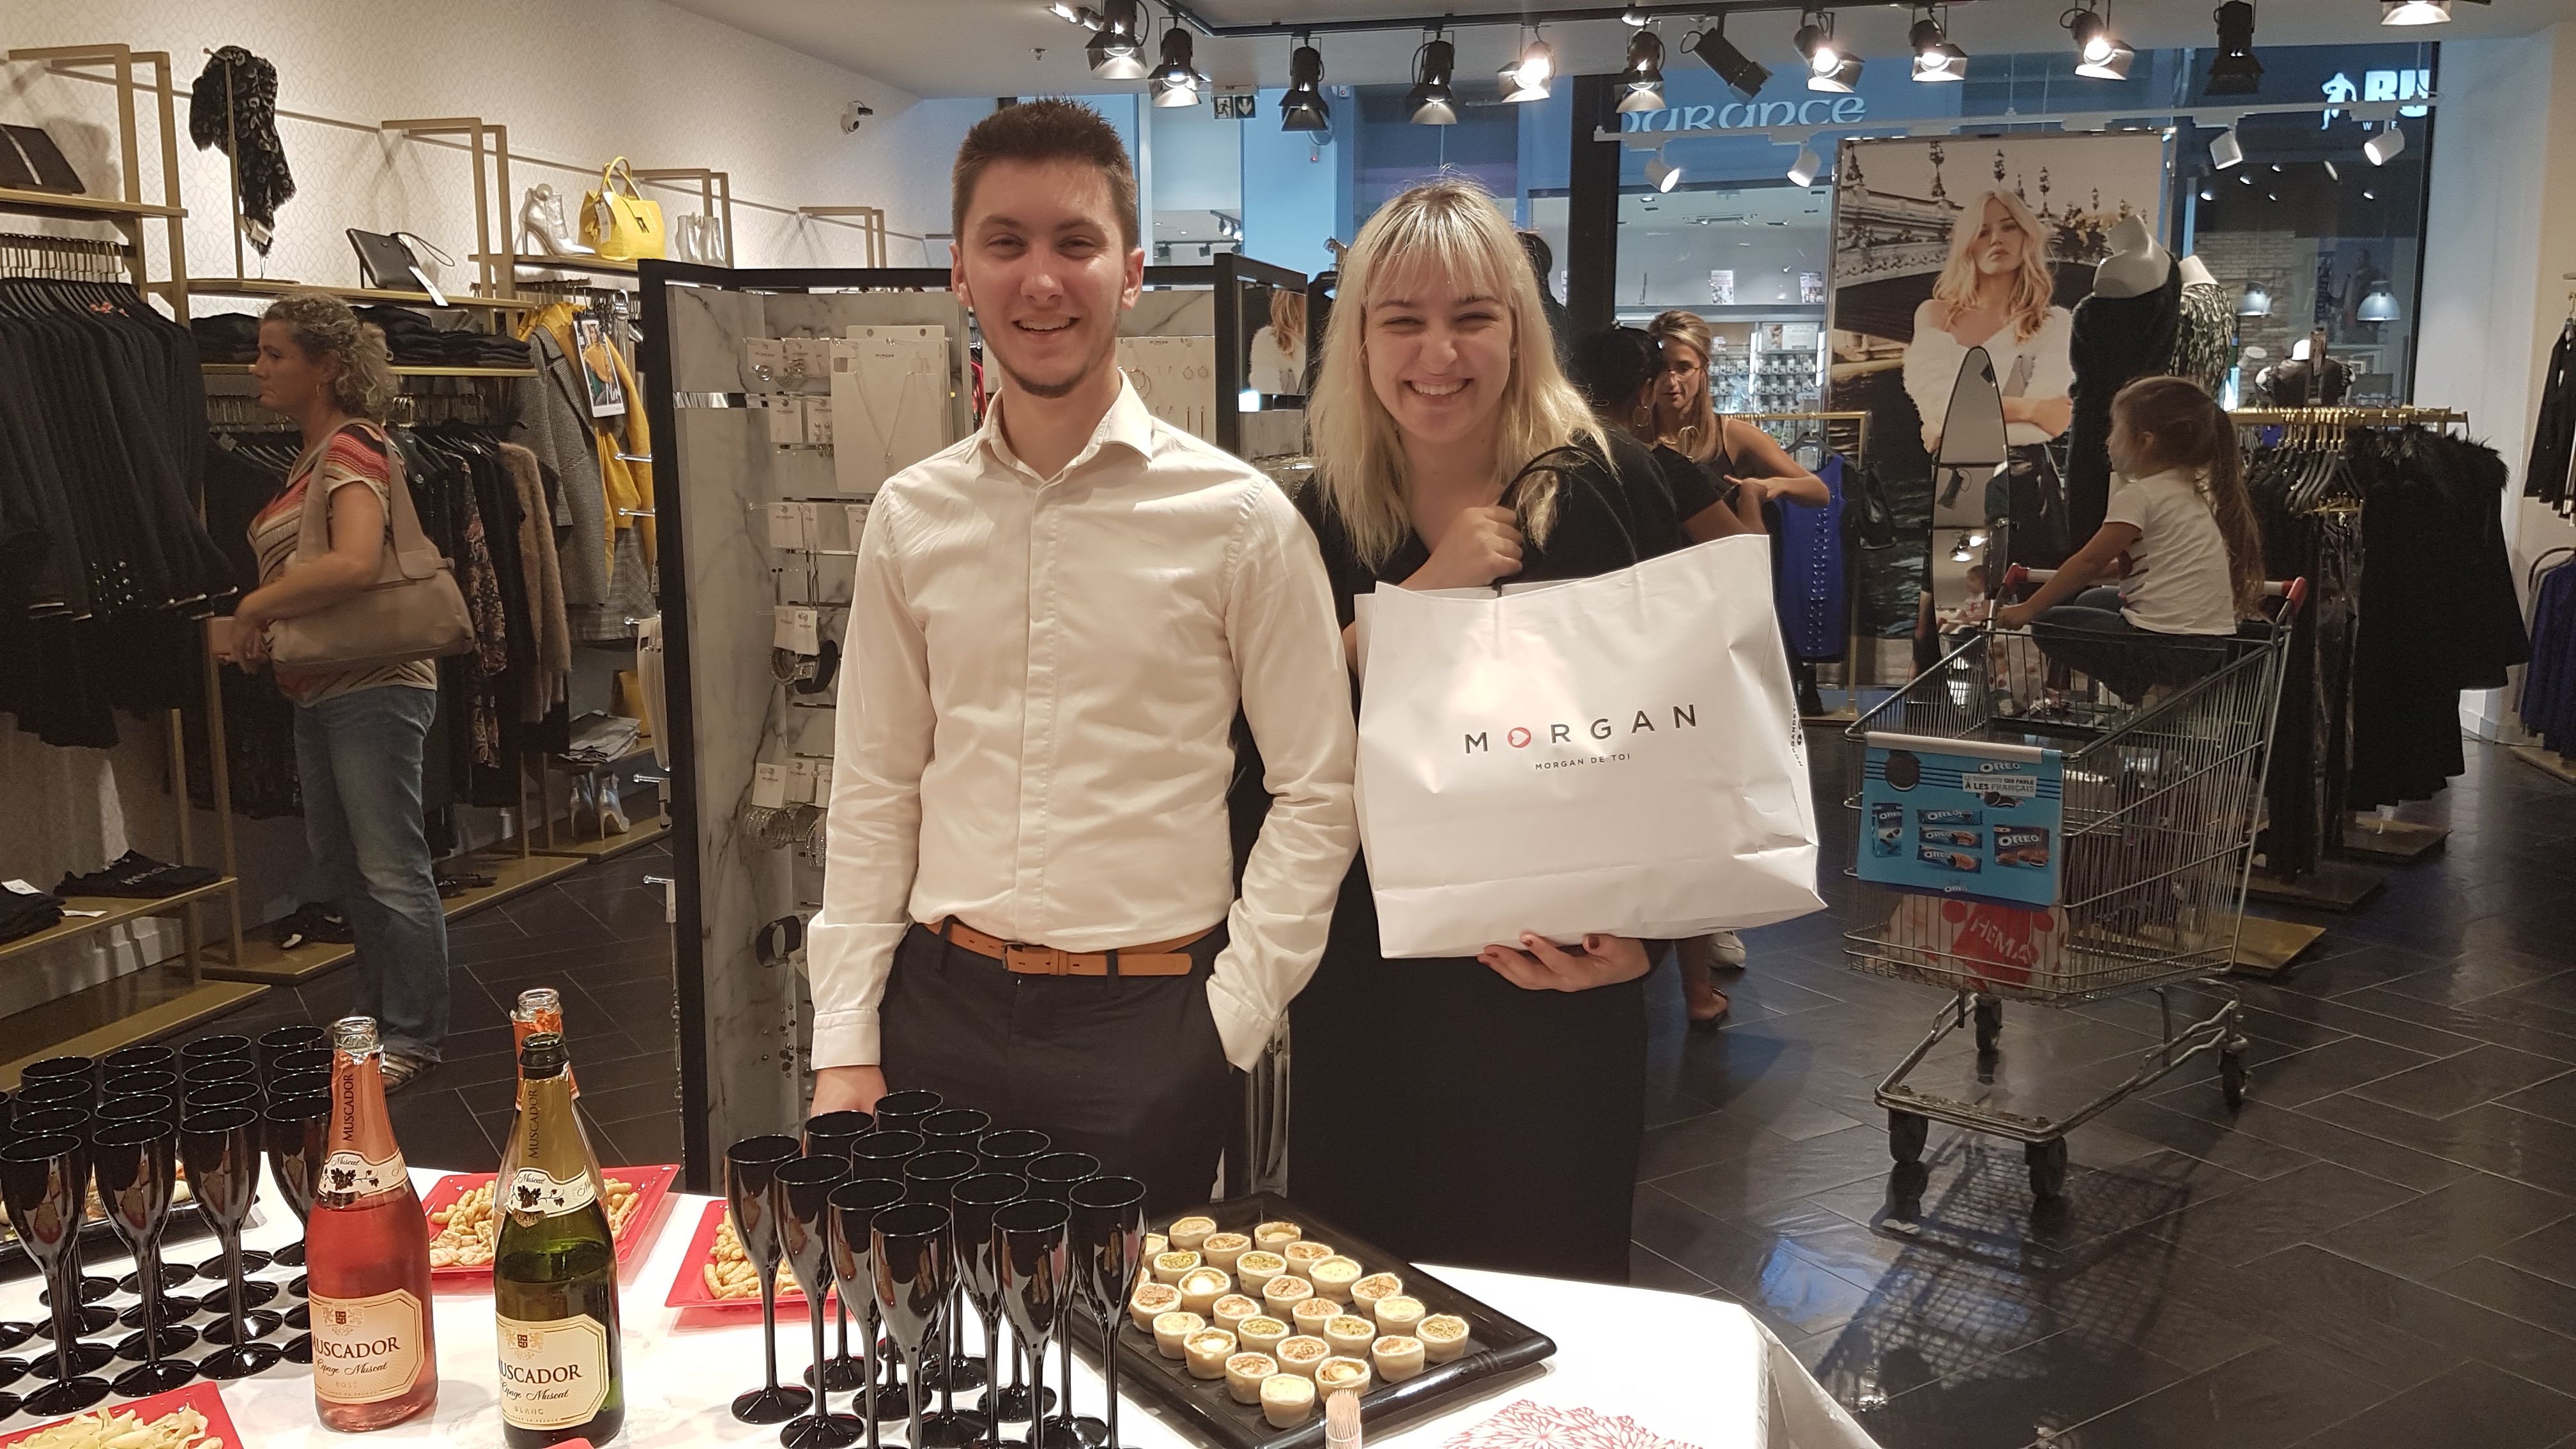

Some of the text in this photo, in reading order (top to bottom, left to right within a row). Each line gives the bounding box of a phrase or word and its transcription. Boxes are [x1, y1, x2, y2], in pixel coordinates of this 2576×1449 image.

[1464, 703, 1697, 755] MORGAN
[1535, 753, 1630, 770] MORGAN DE TOI
[1978, 762, 2021, 774] OREO
[1965, 780, 1972, 790] À
[1991, 783, 2034, 793] FRANÇAIS
[1879, 811, 1902, 820] OREO
[1998, 834, 2039, 847] OREO
[1969, 915, 2031, 965] HEMA
[342, 1073, 355, 1142] MUSCADOR
[528, 1089, 539, 1159] MUSCADOR
[331, 1155, 361, 1167] Muscat
[518, 1173, 547, 1184] Muscat
[344, 1361, 388, 1376] Muscat
[526, 1388, 570, 1401] Muscat
